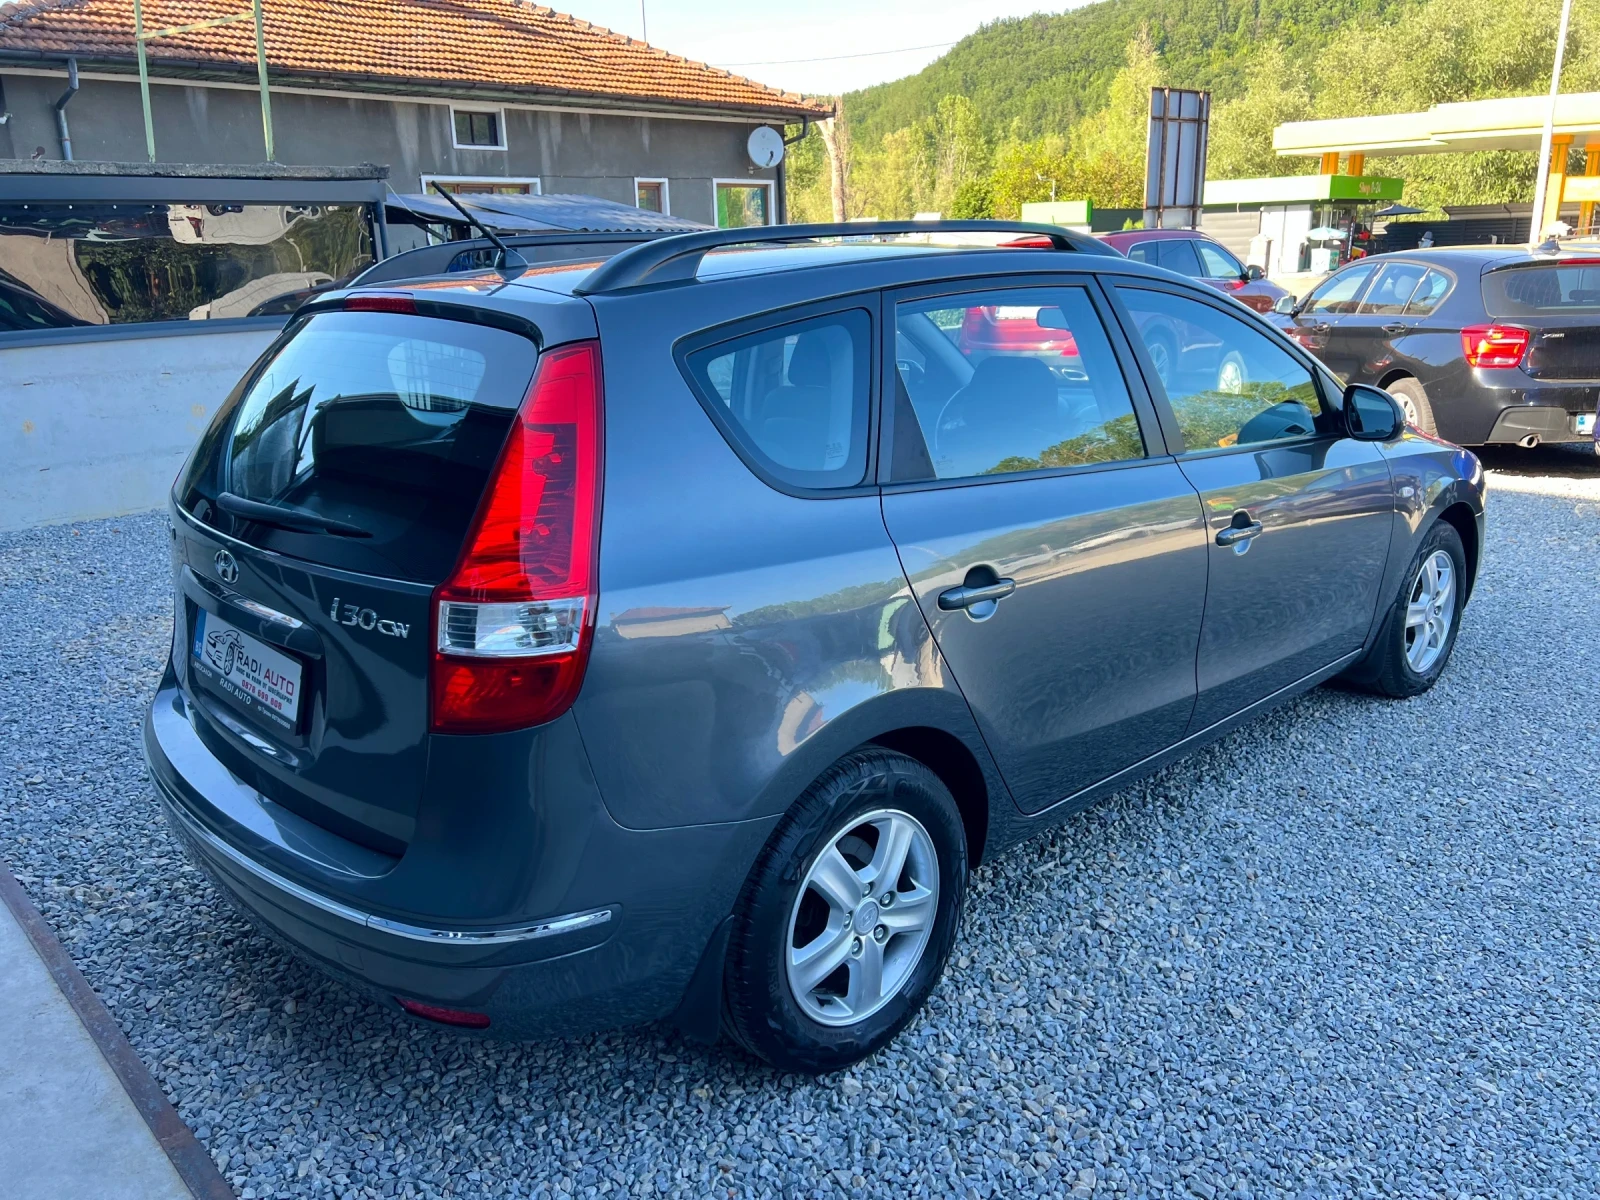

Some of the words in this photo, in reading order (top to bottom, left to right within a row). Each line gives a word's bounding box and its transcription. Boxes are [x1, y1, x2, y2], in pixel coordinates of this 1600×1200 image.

[219, 678, 234, 693] RADI
[234, 688, 252, 705] AUTO
[237, 651, 262, 676] RADI
[264, 668, 295, 697] AUTO
